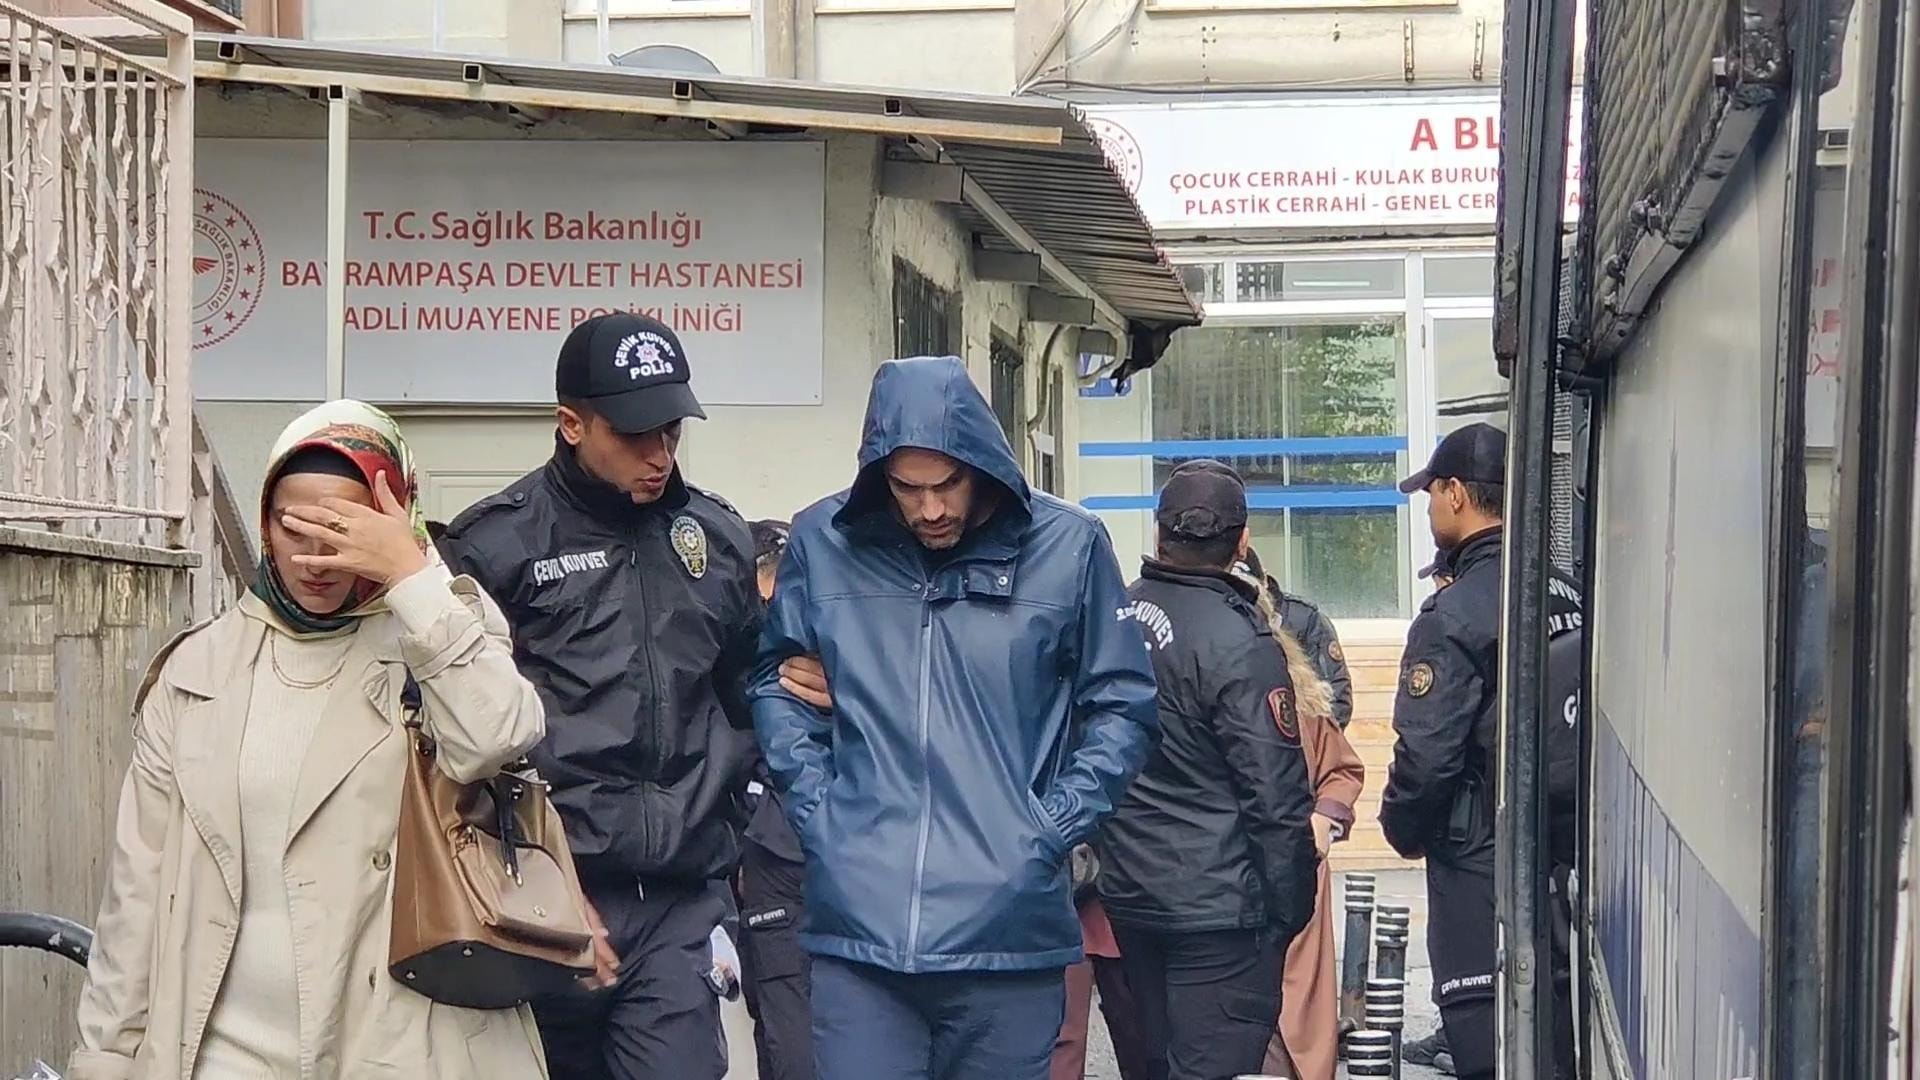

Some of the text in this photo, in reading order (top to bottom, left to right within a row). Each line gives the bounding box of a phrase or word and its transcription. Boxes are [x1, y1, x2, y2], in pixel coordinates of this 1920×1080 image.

[1410, 118, 1438, 151] A
[1170, 173, 1241, 193] ÇOCUK
[1247, 167, 1336, 187] CERRAHİ
[1356, 169, 1425, 186] KULAK
[1185, 195, 1270, 215] PLASTİK
[1276, 193, 1365, 213] CERRAHİ
[1385, 195, 1452, 211] GENEL
[431, 210, 534, 247] Sağlık
[544, 211, 702, 248] Bakanlığı
[281, 259, 802, 293] BARAMPAŞA DEVLET HASTANESİ
[345, 302, 742, 332] ADLİ MUAYENE PİNİĞİ
[614, 331, 676, 368] ÇEVİK KUVVET
[629, 361, 674, 380] POLİS
[559, 550, 609, 574] KUVVET
